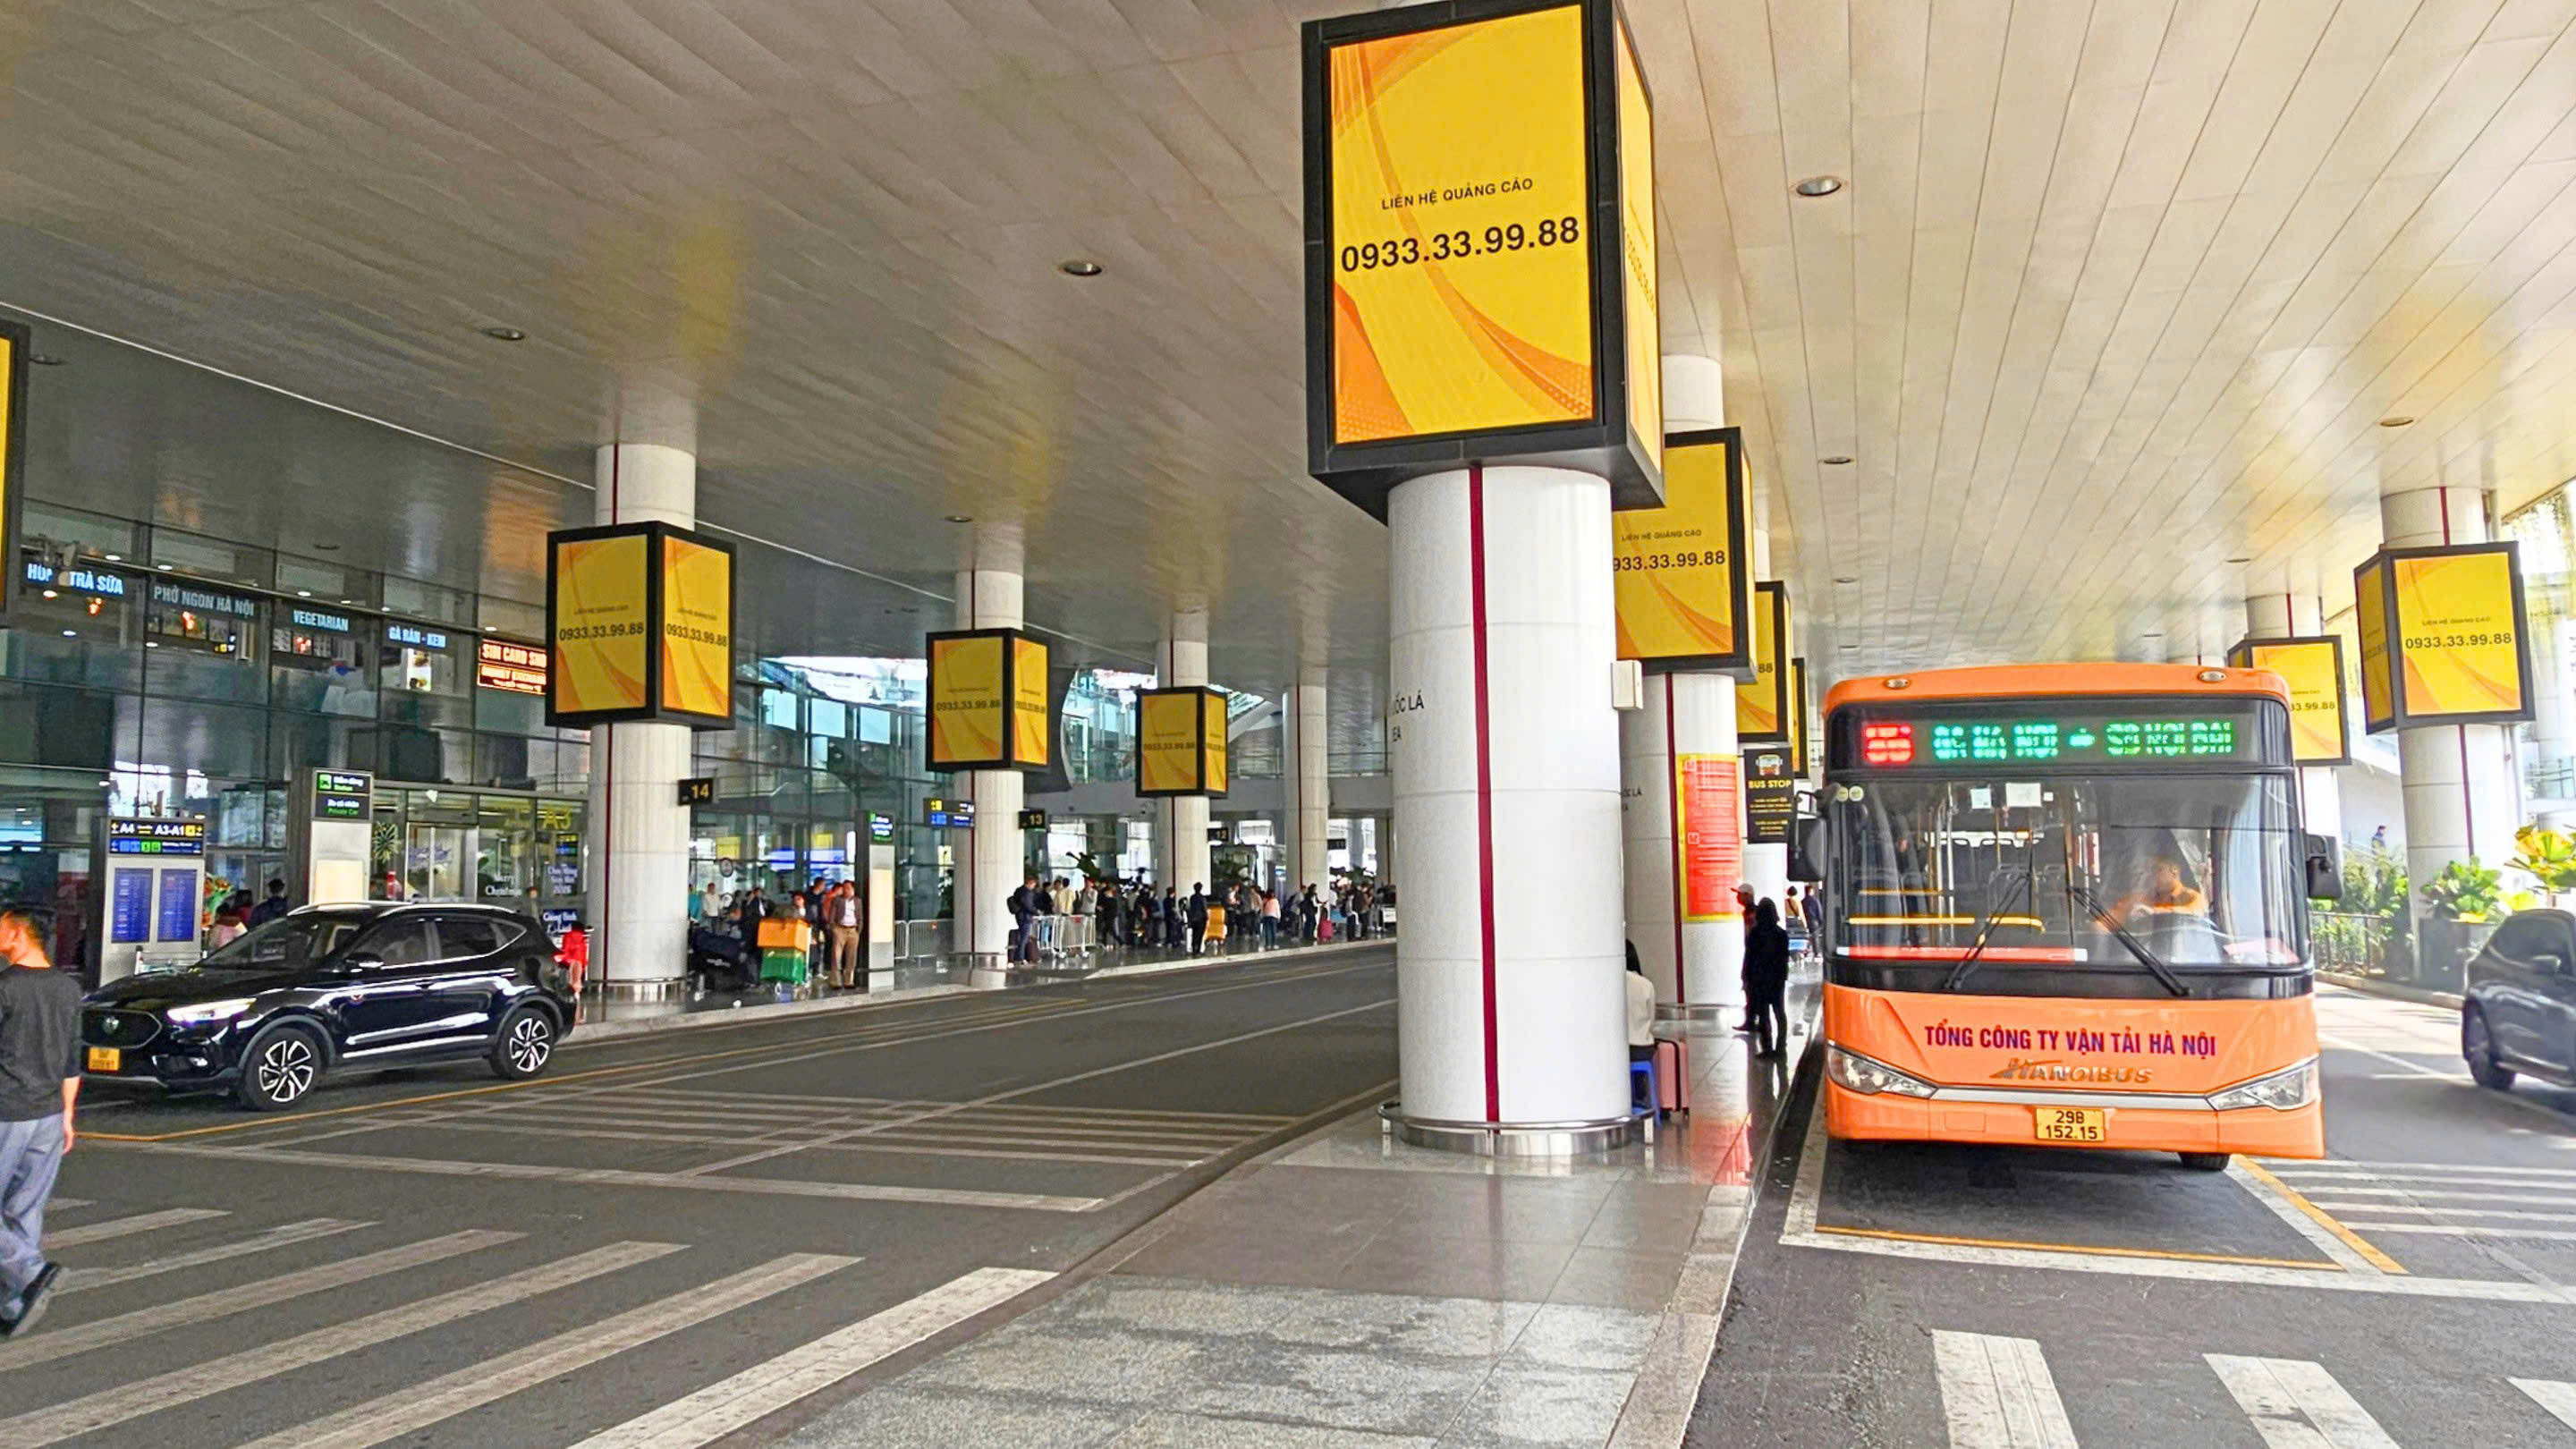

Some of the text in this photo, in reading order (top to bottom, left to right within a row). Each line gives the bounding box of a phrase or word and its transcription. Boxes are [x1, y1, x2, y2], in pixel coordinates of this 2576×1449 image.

[1382, 177, 1533, 210] LIÊN HỆ QUẢNG CÁO
[1341, 216, 1579, 272] 0933.33.99.88
[70, 570, 94, 589] TRÀ
[97, 574, 123, 595] SỮA
[182, 590, 214, 610] NGON
[216, 597, 232, 613] HÀ
[234, 600, 254, 618] NỘI
[292, 610, 349, 631] VEGETARIAN
[559, 623, 645, 641] 0933.33.99.88
[665, 623, 727, 648] 0933.33.99.88
[2405, 632, 2512, 649] 0933.33.99.88
[691, 784, 709, 799] 14
[1748, 779, 1792, 789] BUS STOP
[120, 823, 135, 834] A4
[1029, 814, 1042, 825] 13
[1925, 1018, 2216, 1059] TỔNG CÔNG TY VẬN TẢI HÀ NỘI
[2055, 1110, 2085, 1124] 29B
[2046, 1125, 2097, 1140] 152.15
